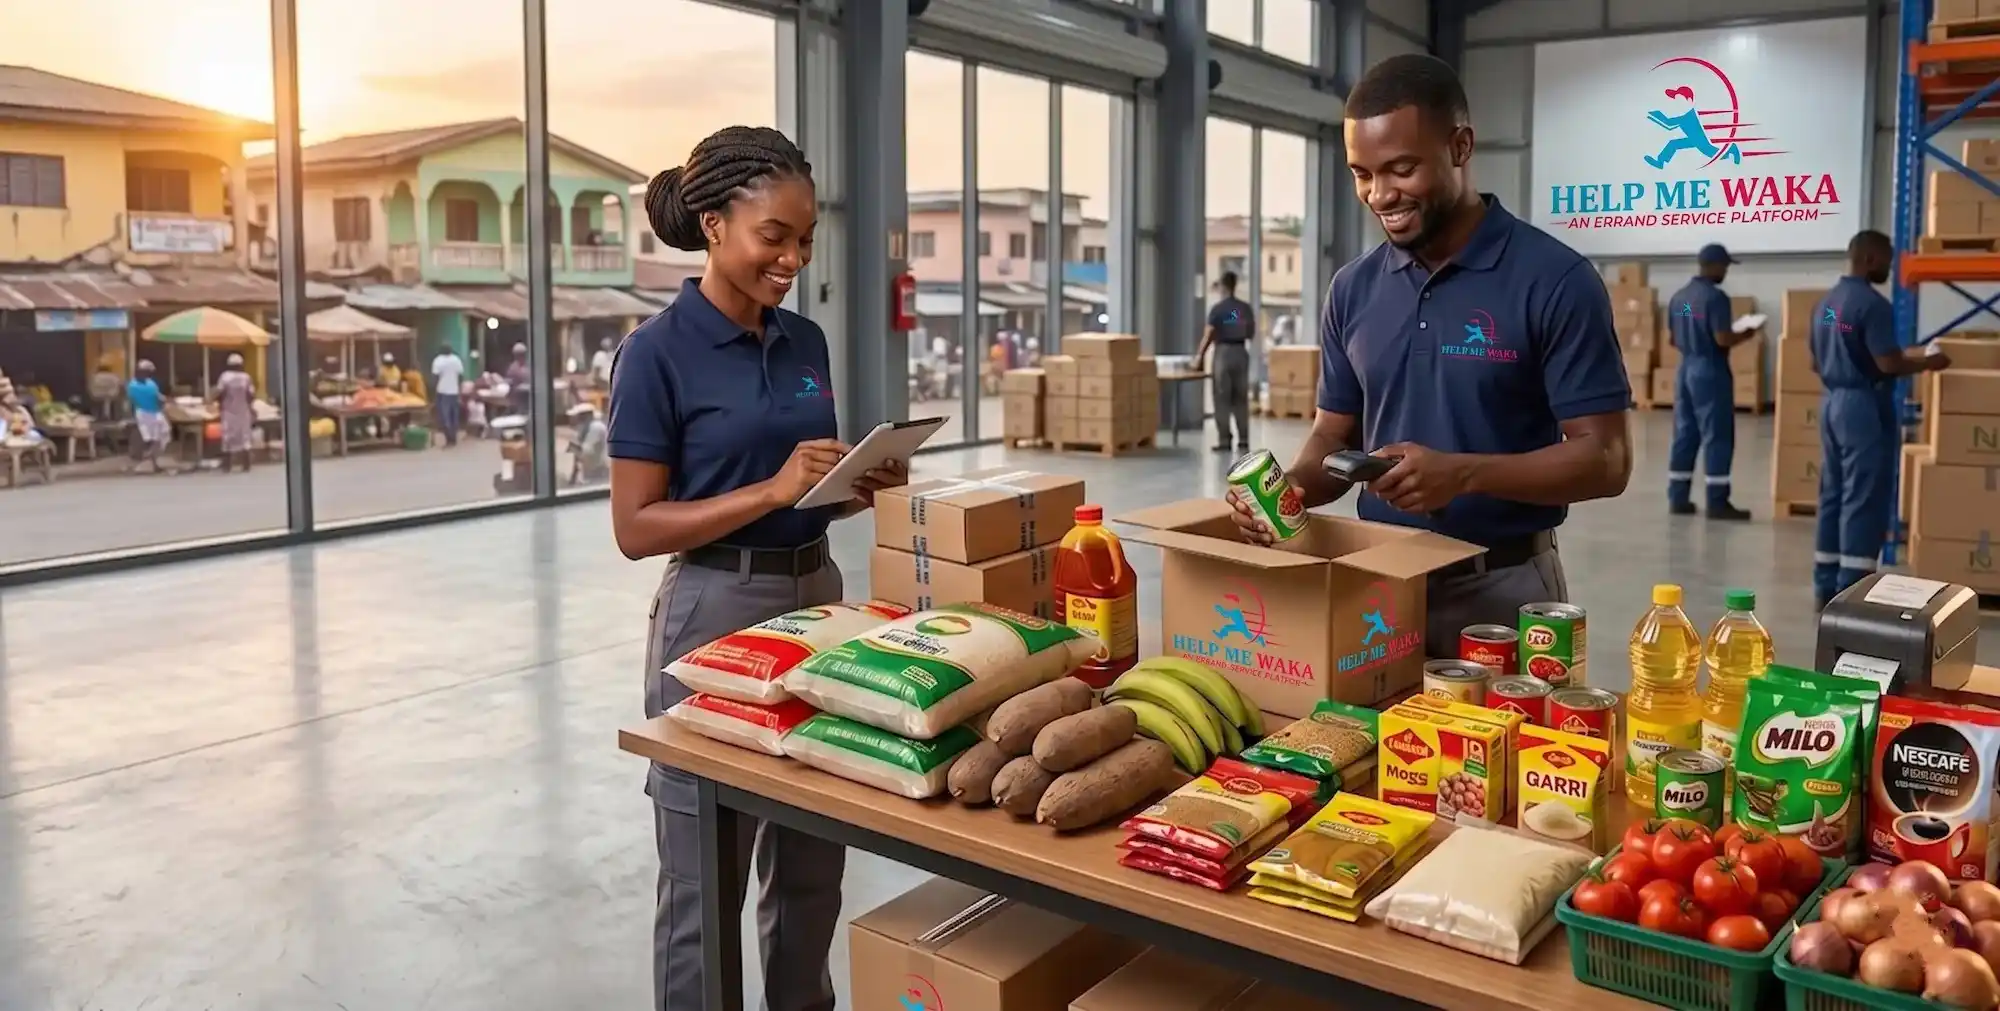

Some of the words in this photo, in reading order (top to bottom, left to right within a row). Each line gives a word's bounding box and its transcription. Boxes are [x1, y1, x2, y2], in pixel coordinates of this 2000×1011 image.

[1551, 183, 1645, 214] HELP
[1655, 180, 1710, 210] ME
[1720, 174, 1840, 207] WAKA
[1568, 217, 1591, 229] AN
[1594, 215, 1658, 228] ERRAND
[1661, 211, 1727, 226] SERVICE
[1731, 209, 1819, 224] PLATFORM
[1487, 348, 1518, 359] WAKA
[1173, 634, 1219, 657] HELP
[1224, 646, 1252, 666] ME
[1256, 652, 1315, 681] WAKA
[1338, 649, 1368, 673] HELP
[1370, 643, 1386, 661] ME
[1388, 630, 1420, 654] WAKA
[1764, 727, 1836, 752] MILO
[1526, 770, 1588, 799] GARRI
[1664, 789, 1705, 804] MILO
